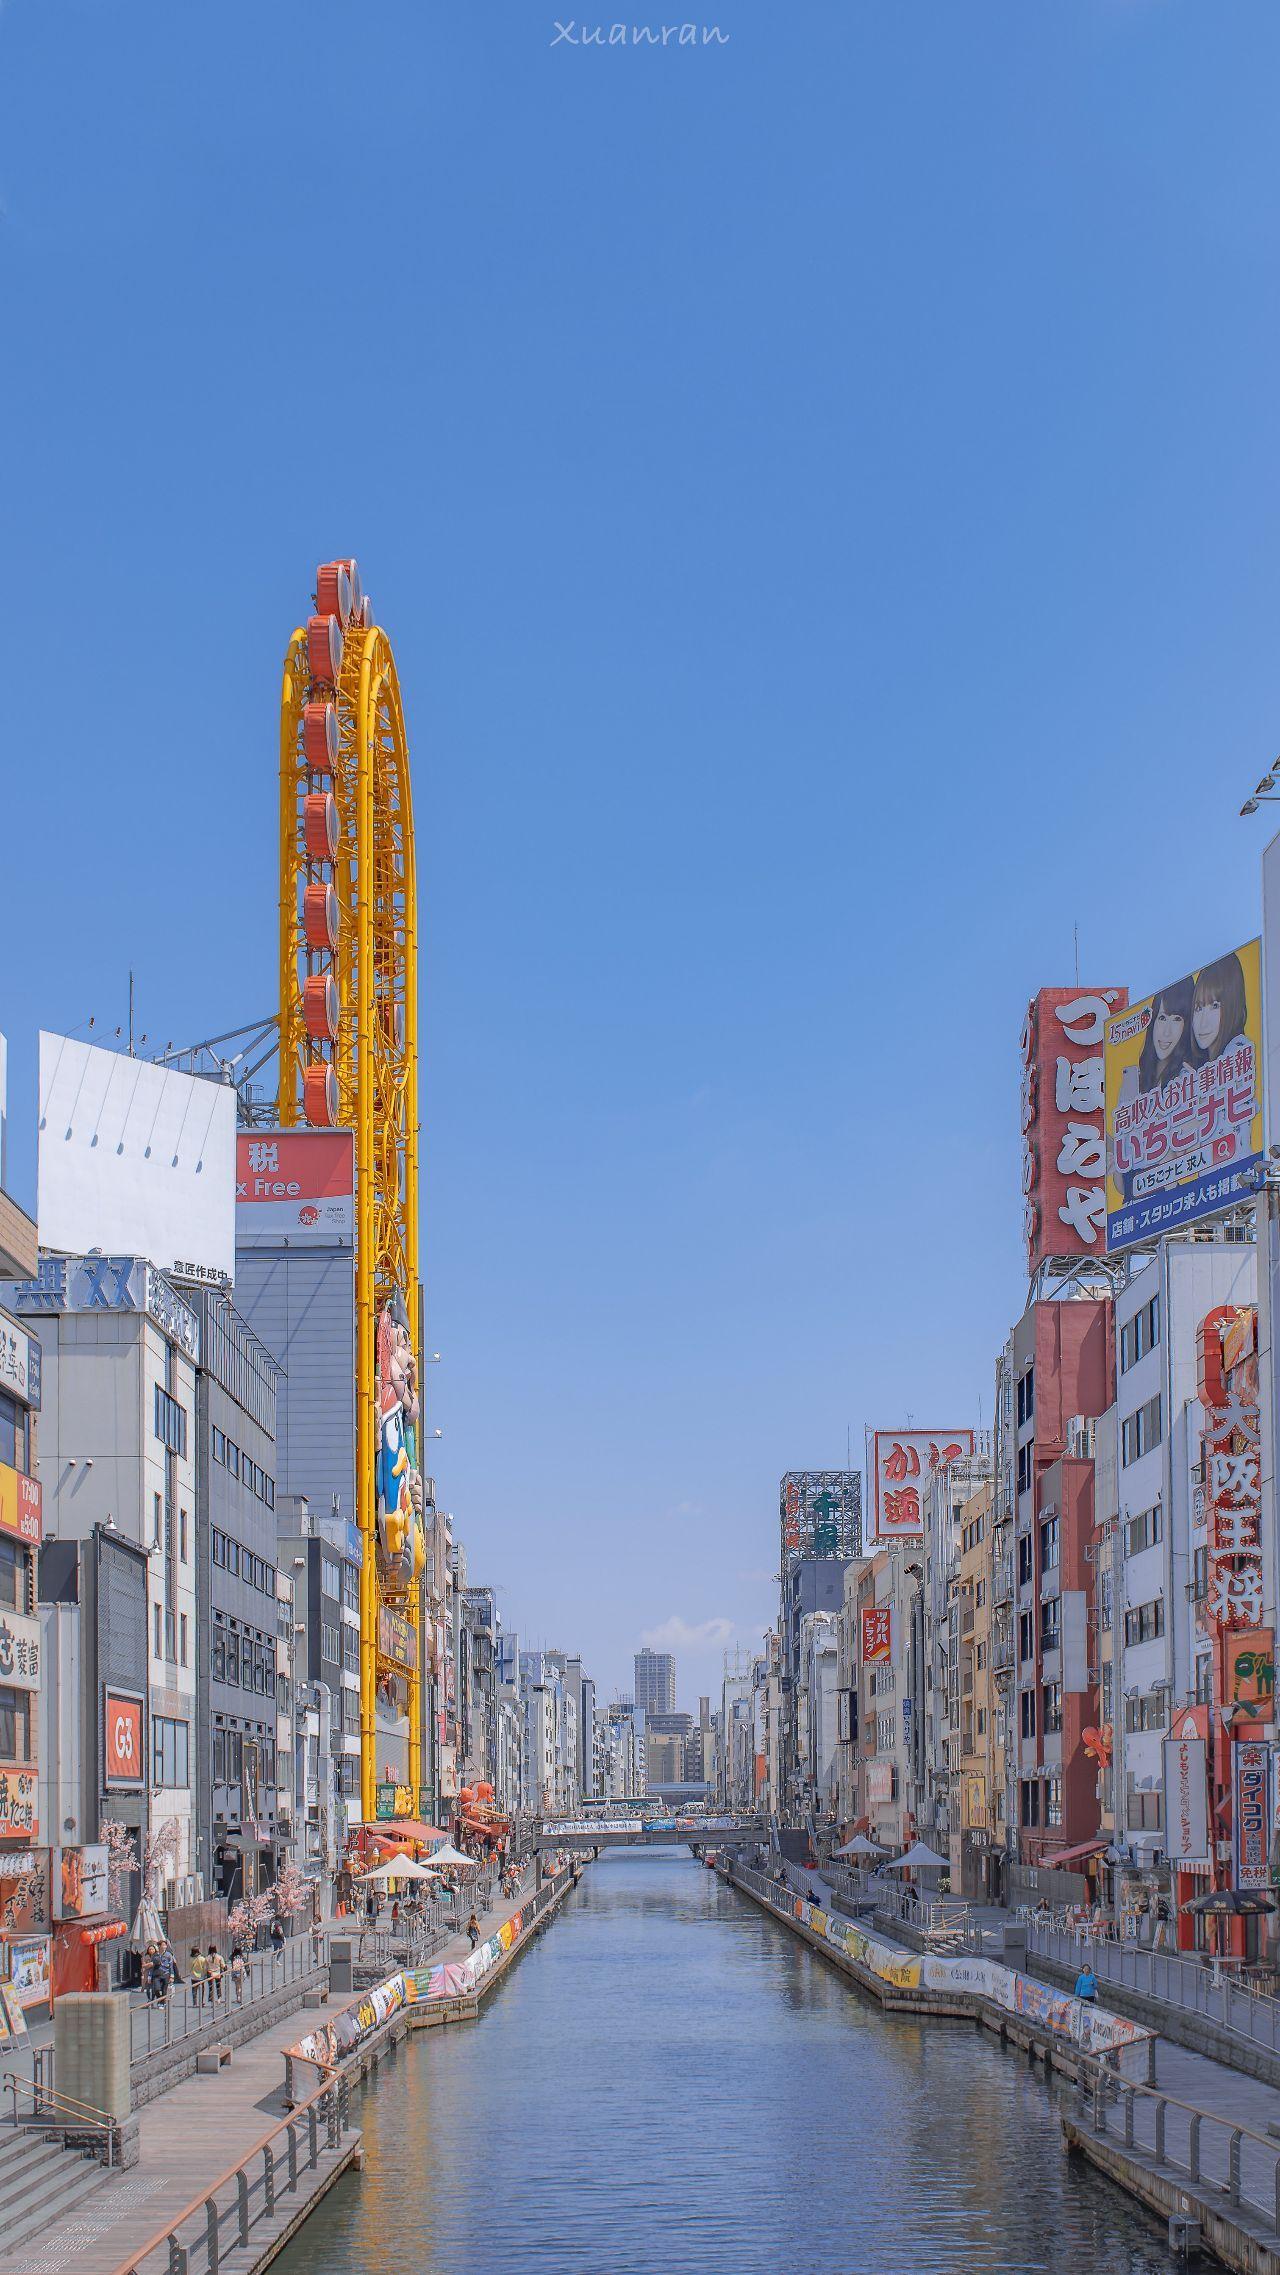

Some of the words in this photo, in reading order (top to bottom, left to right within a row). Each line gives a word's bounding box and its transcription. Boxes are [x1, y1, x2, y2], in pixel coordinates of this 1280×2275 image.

[1115, 1046, 1253, 1134] 高収入お仕事情報
[1116, 1074, 1253, 1170] いちごナビ
[248, 1142, 279, 1173] 税
[1136, 1160, 1184, 1192] いちごナビ
[1186, 1151, 1207, 1172] 求人
[254, 1178, 301, 1196] Free
[173, 1260, 229, 1281] 意匠作成中
[1200, 1393, 1263, 1627] 大阪王将
[865, 1617, 876, 1653] ドラッグ
[876, 1611, 889, 1644] ツルハ
[115, 1716, 133, 1759] G3
[1241, 1770, 1263, 1833] ダイコク
[1240, 1866, 1267, 1879] 免税
